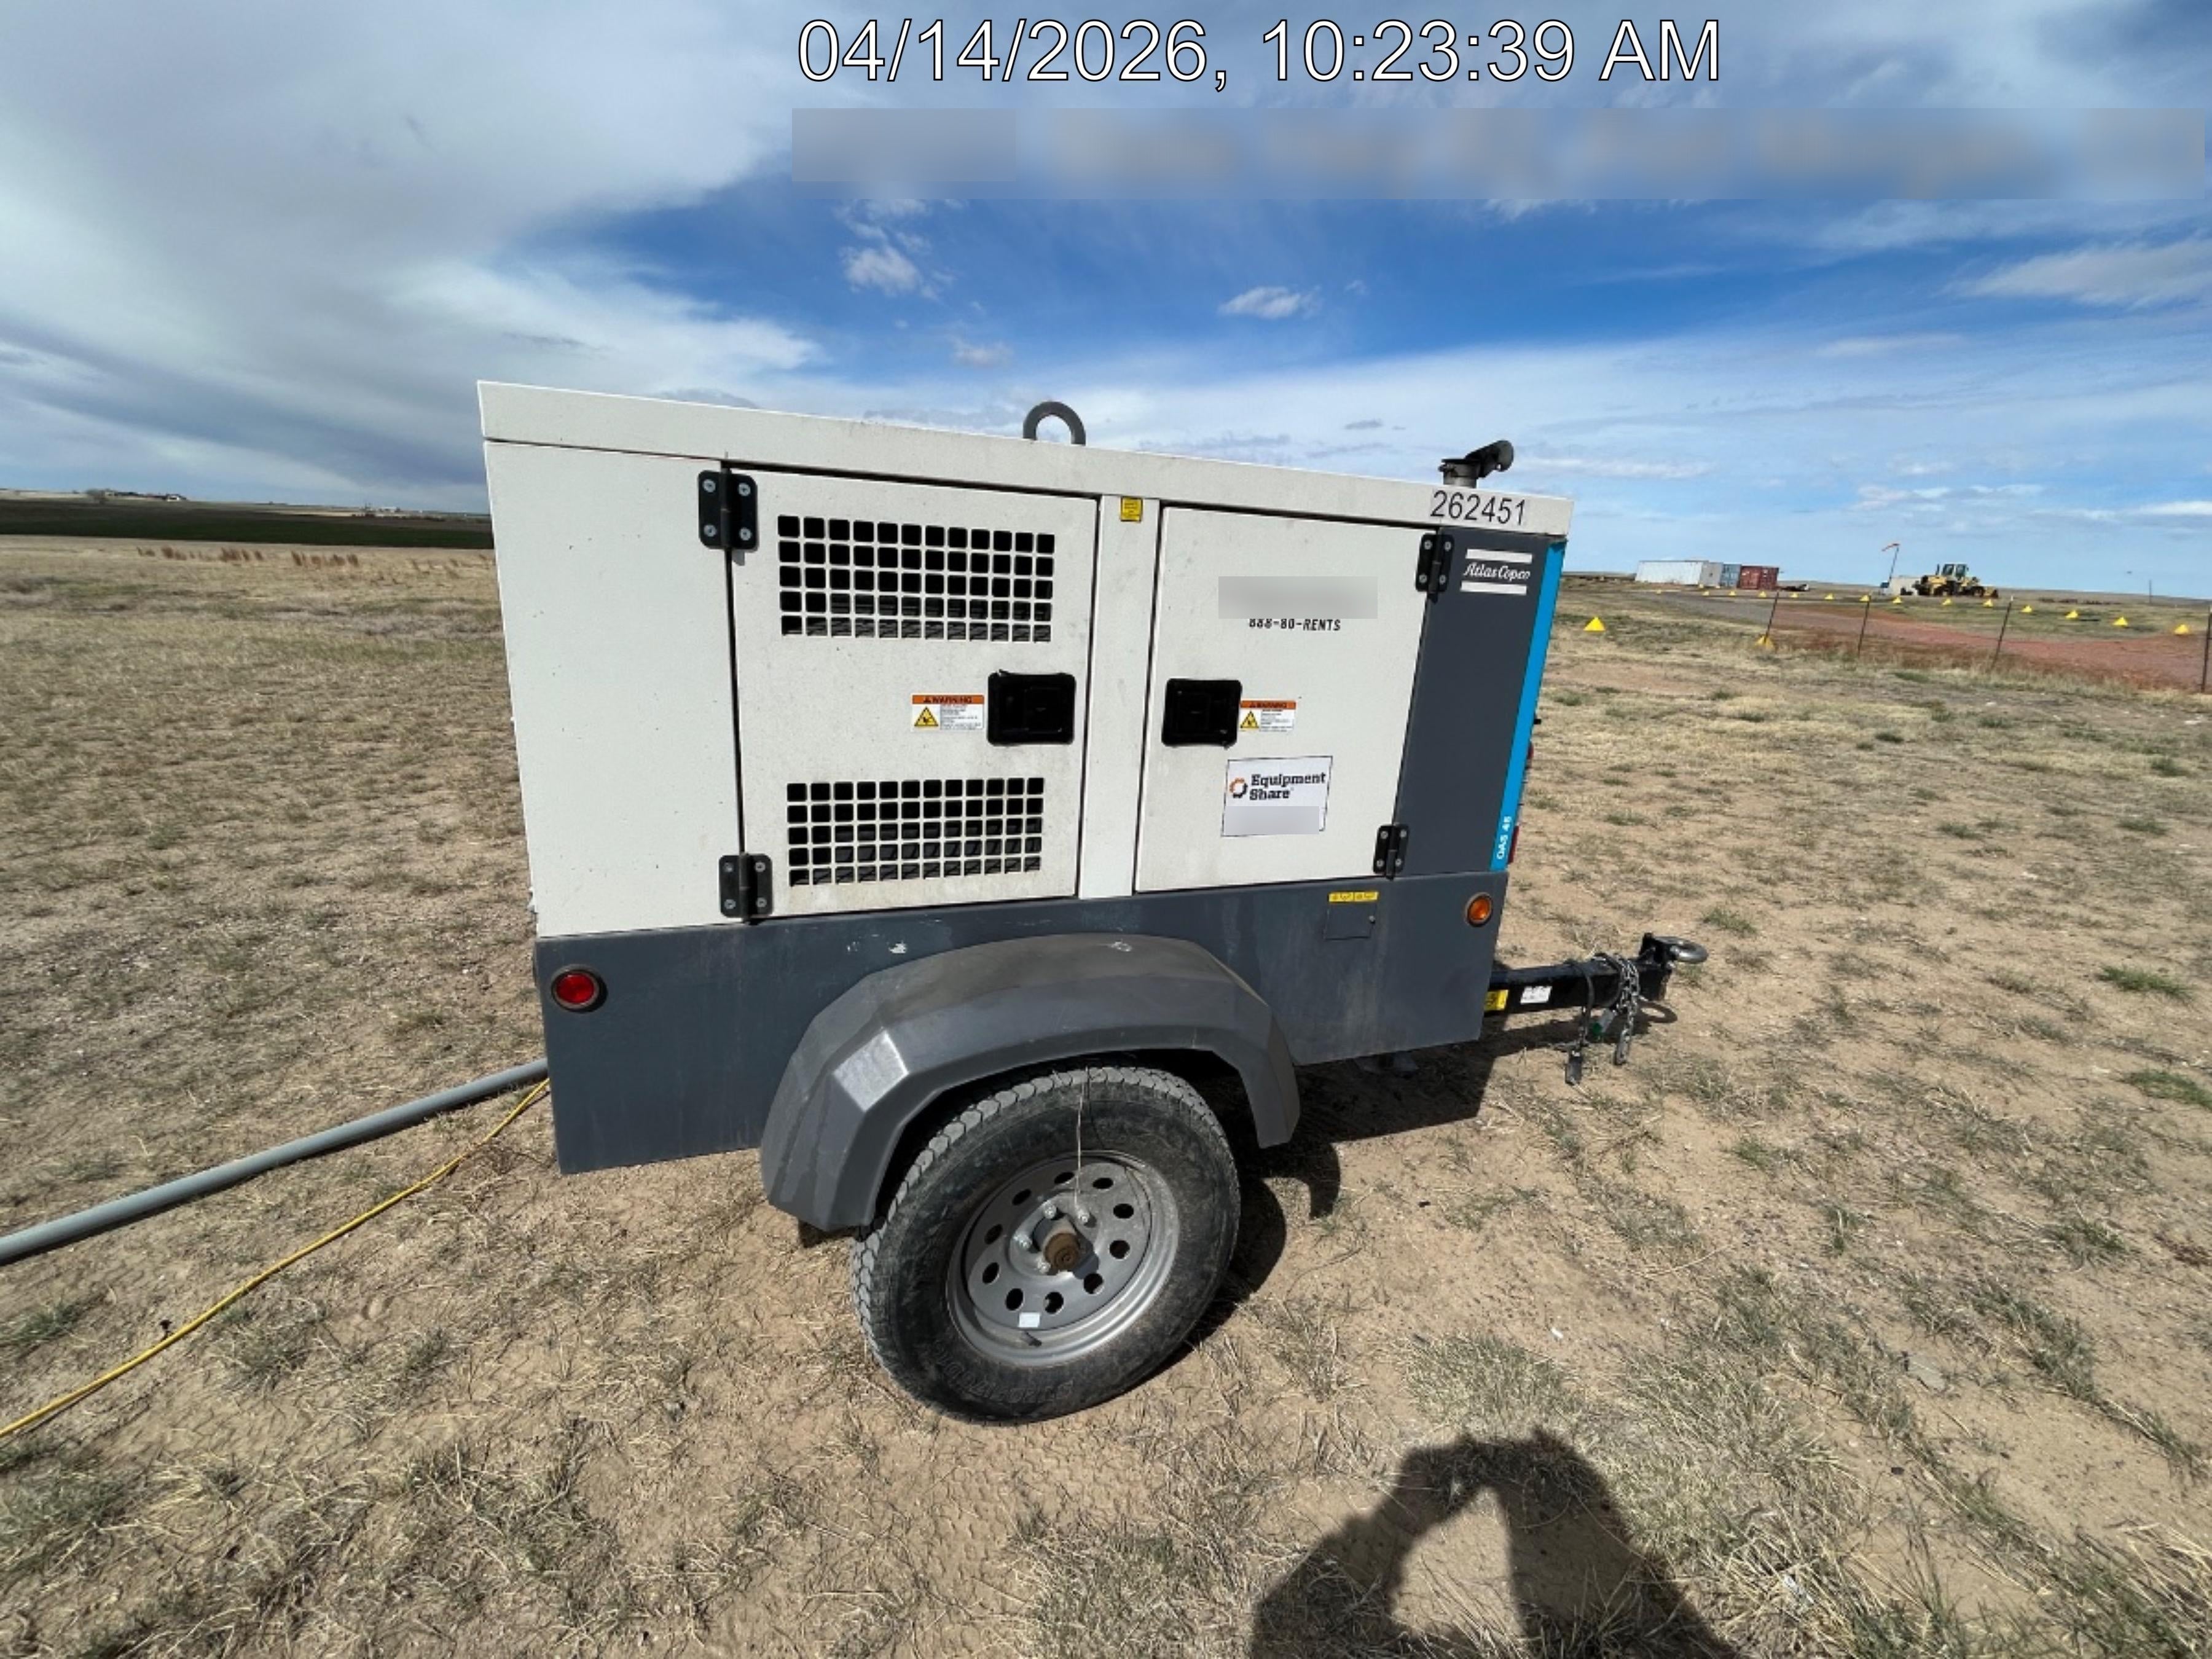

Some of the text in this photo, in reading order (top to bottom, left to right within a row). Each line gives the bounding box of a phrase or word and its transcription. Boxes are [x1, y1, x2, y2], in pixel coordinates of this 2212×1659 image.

[1430, 490, 1525, 525] 262451
[1463, 562, 1497, 579] Atlas
[1251, 772, 1327, 788] Equipment
[1249, 788, 1290, 800] Share
